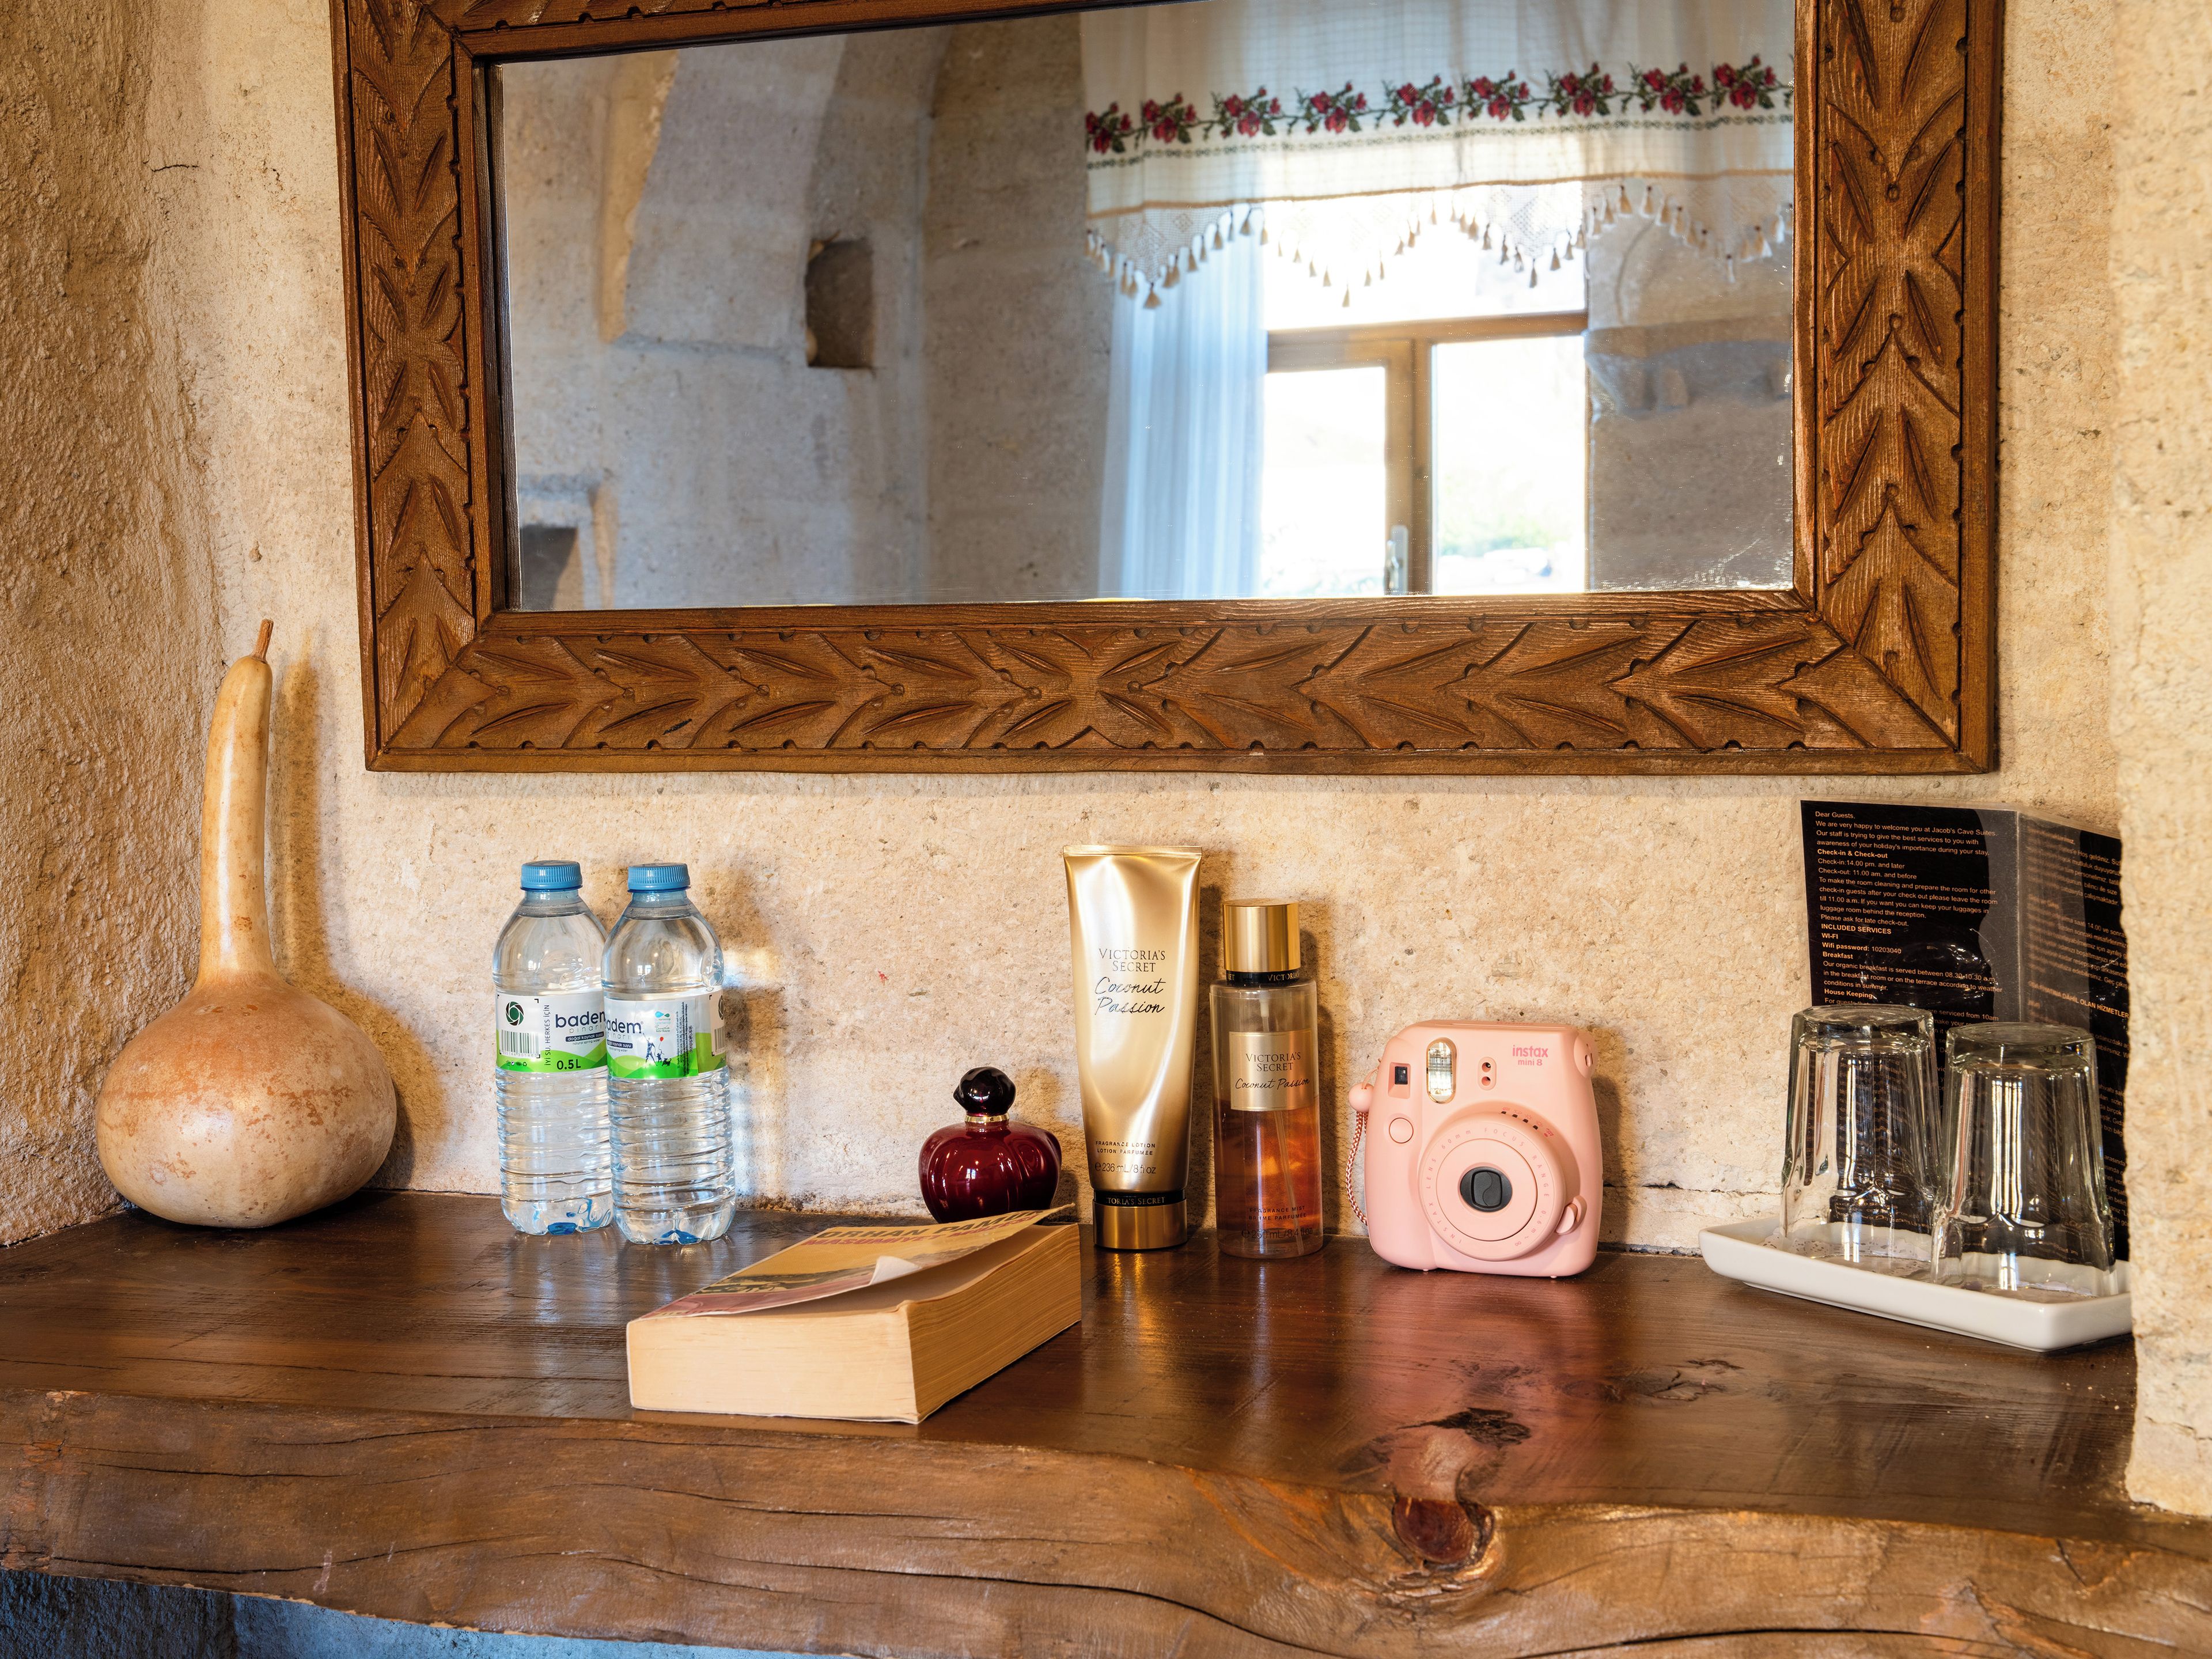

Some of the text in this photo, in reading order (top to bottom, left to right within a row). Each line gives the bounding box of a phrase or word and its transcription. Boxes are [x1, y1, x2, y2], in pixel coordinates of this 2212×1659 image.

[1854, 823, 1873, 831] happy
[1850, 832, 1868, 840] trying
[1854, 850, 1888, 858] Check-out
[1873, 842, 1901, 851] holiday's
[1902, 844, 1937, 853] importance
[1938, 846, 1958, 855] during
[1818, 868, 1851, 876] Check-out:
[1874, 881, 1900, 889] cleaning
[1820, 904, 1844, 913] luggage
[1863, 907, 1884, 915] behind
[1821, 914, 1841, 922] Please
[1877, 918, 1909, 927] check-out.
[1821, 923, 1892, 934] INCLUDED SERVICES
[1099, 948, 1165, 961] VICTORIA'S
[1835, 944, 1870, 952] password:
[1872, 946, 1902, 955] 10203040
[1823, 951, 1853, 960] Breakfast
[1112, 960, 1156, 972] SECRET
[1859, 964, 1887, 972] breakfast
[1917, 969, 1944, 978] between
[1094, 976, 1166, 995] Coconut
[1846, 990, 1873, 999] Keeping
[1094, 996, 1165, 1016] Passion
[2080, 999, 2096, 1009] OLAN
[607, 1018, 642, 1033] adem
[1513, 1044, 1548, 1058] instax
[1245, 1052, 1301, 1063] VICTORIA'S
[1257, 1062, 1294, 1073] SECRET
[1235, 1077, 1310, 1090] Coconut Passion
[1137, 1197, 1165, 1205] SECRET
[817, 1228, 931, 1238] ORHAN
